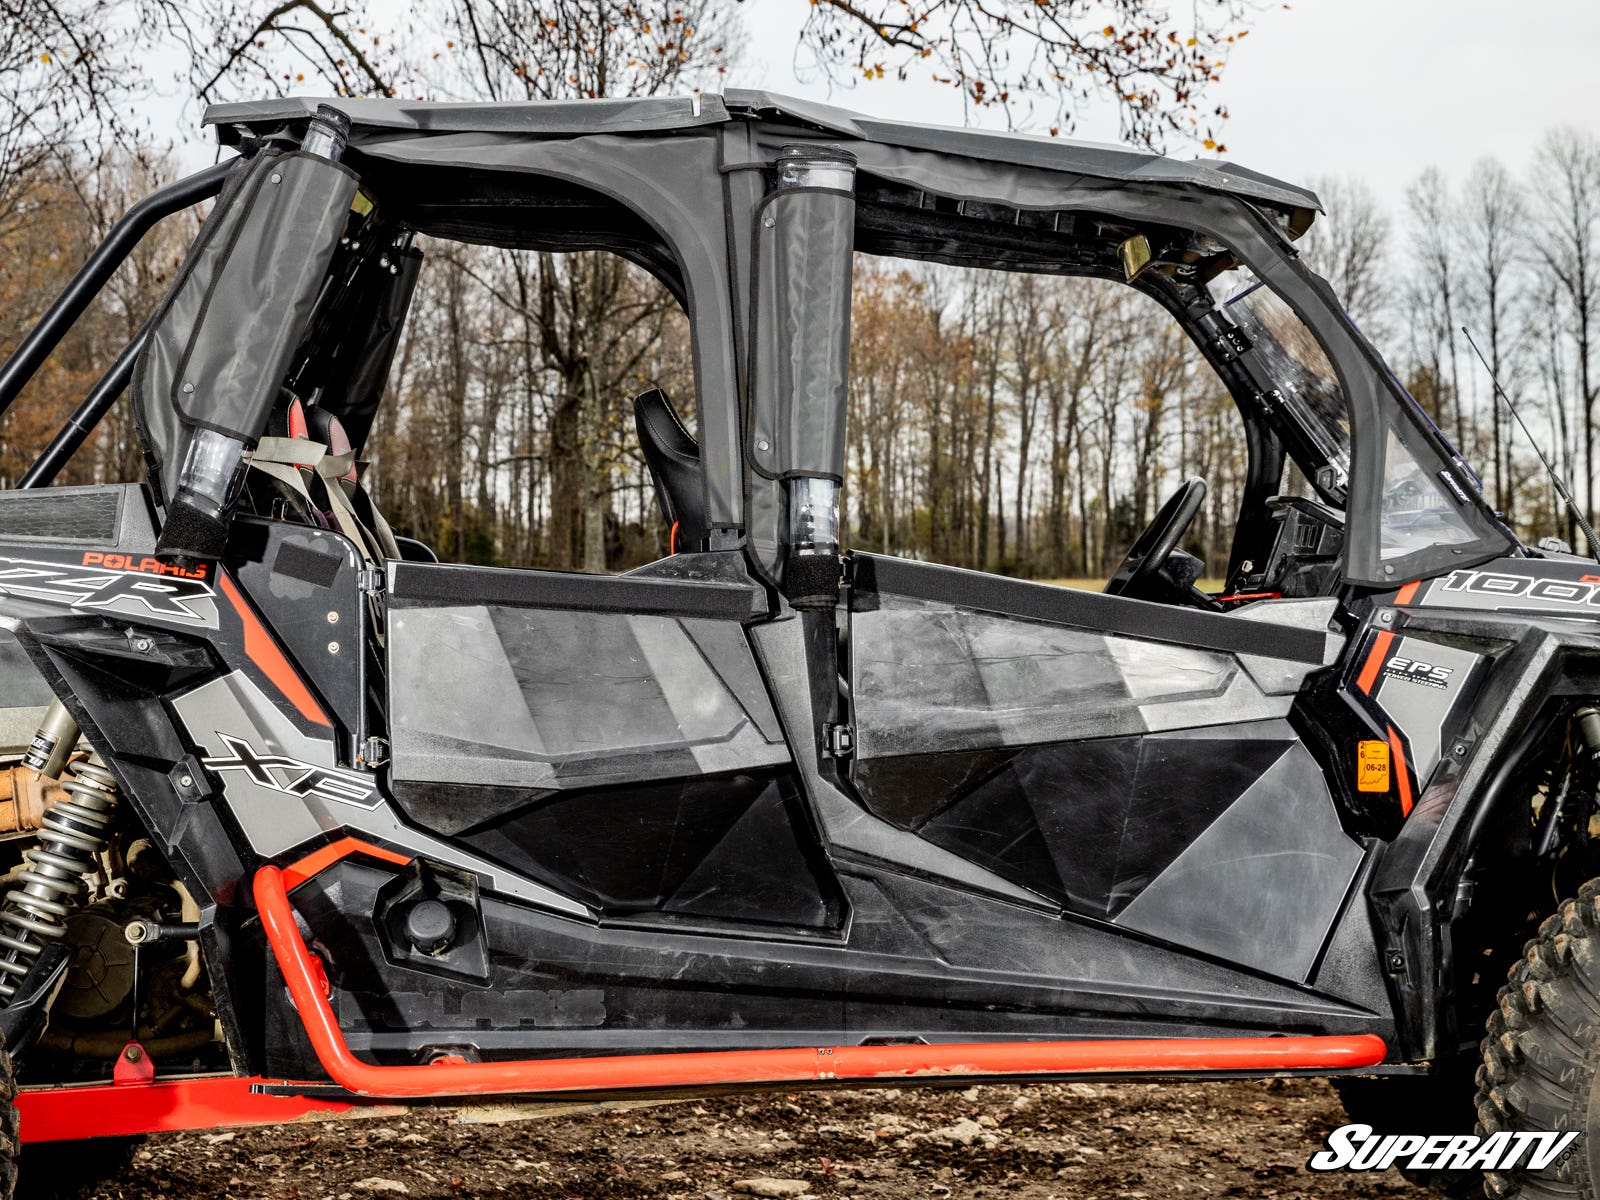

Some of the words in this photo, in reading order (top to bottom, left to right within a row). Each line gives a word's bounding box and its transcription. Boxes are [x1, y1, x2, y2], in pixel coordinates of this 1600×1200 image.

[1441, 569, 1600, 607] 100
[1386, 656, 1454, 680] EPS
[1366, 763, 1387, 772] 06-28
